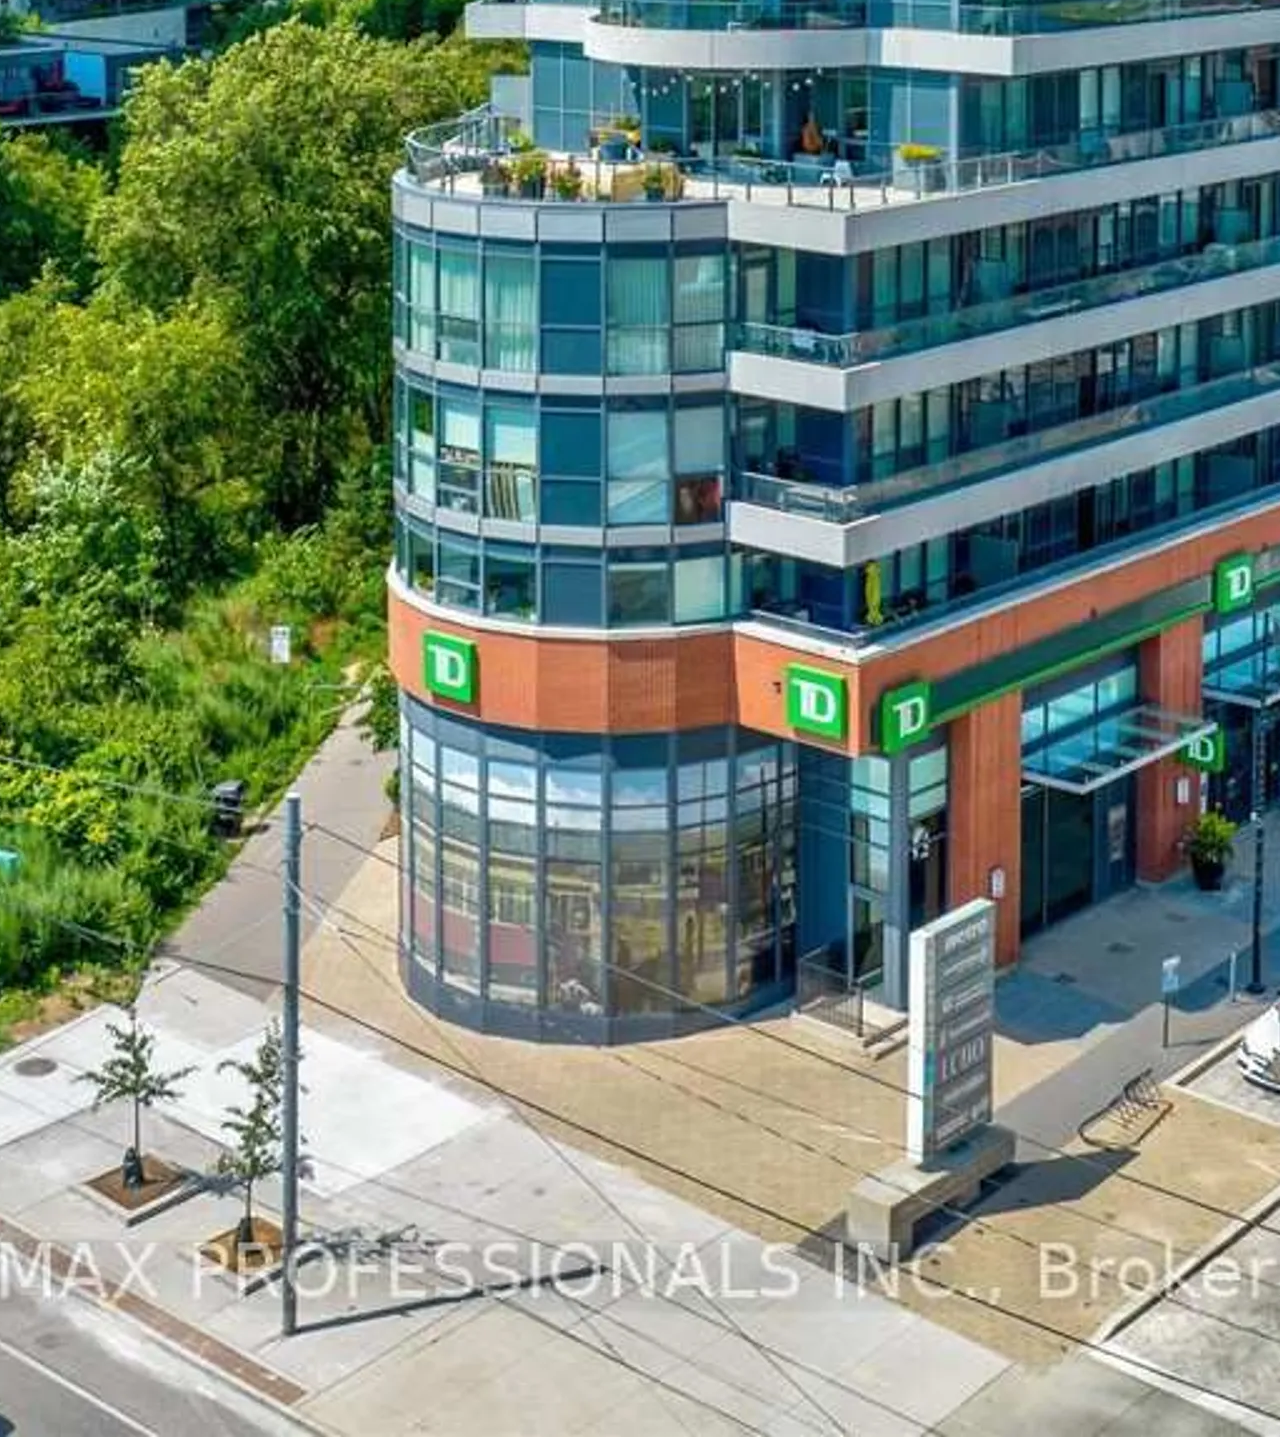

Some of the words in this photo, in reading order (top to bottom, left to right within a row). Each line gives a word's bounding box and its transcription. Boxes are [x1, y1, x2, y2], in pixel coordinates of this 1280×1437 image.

[1225, 566, 1251, 601] TD
[427, 644, 467, 689] TD
[791, 677, 837, 724] TD
[892, 696, 926, 739] TD
